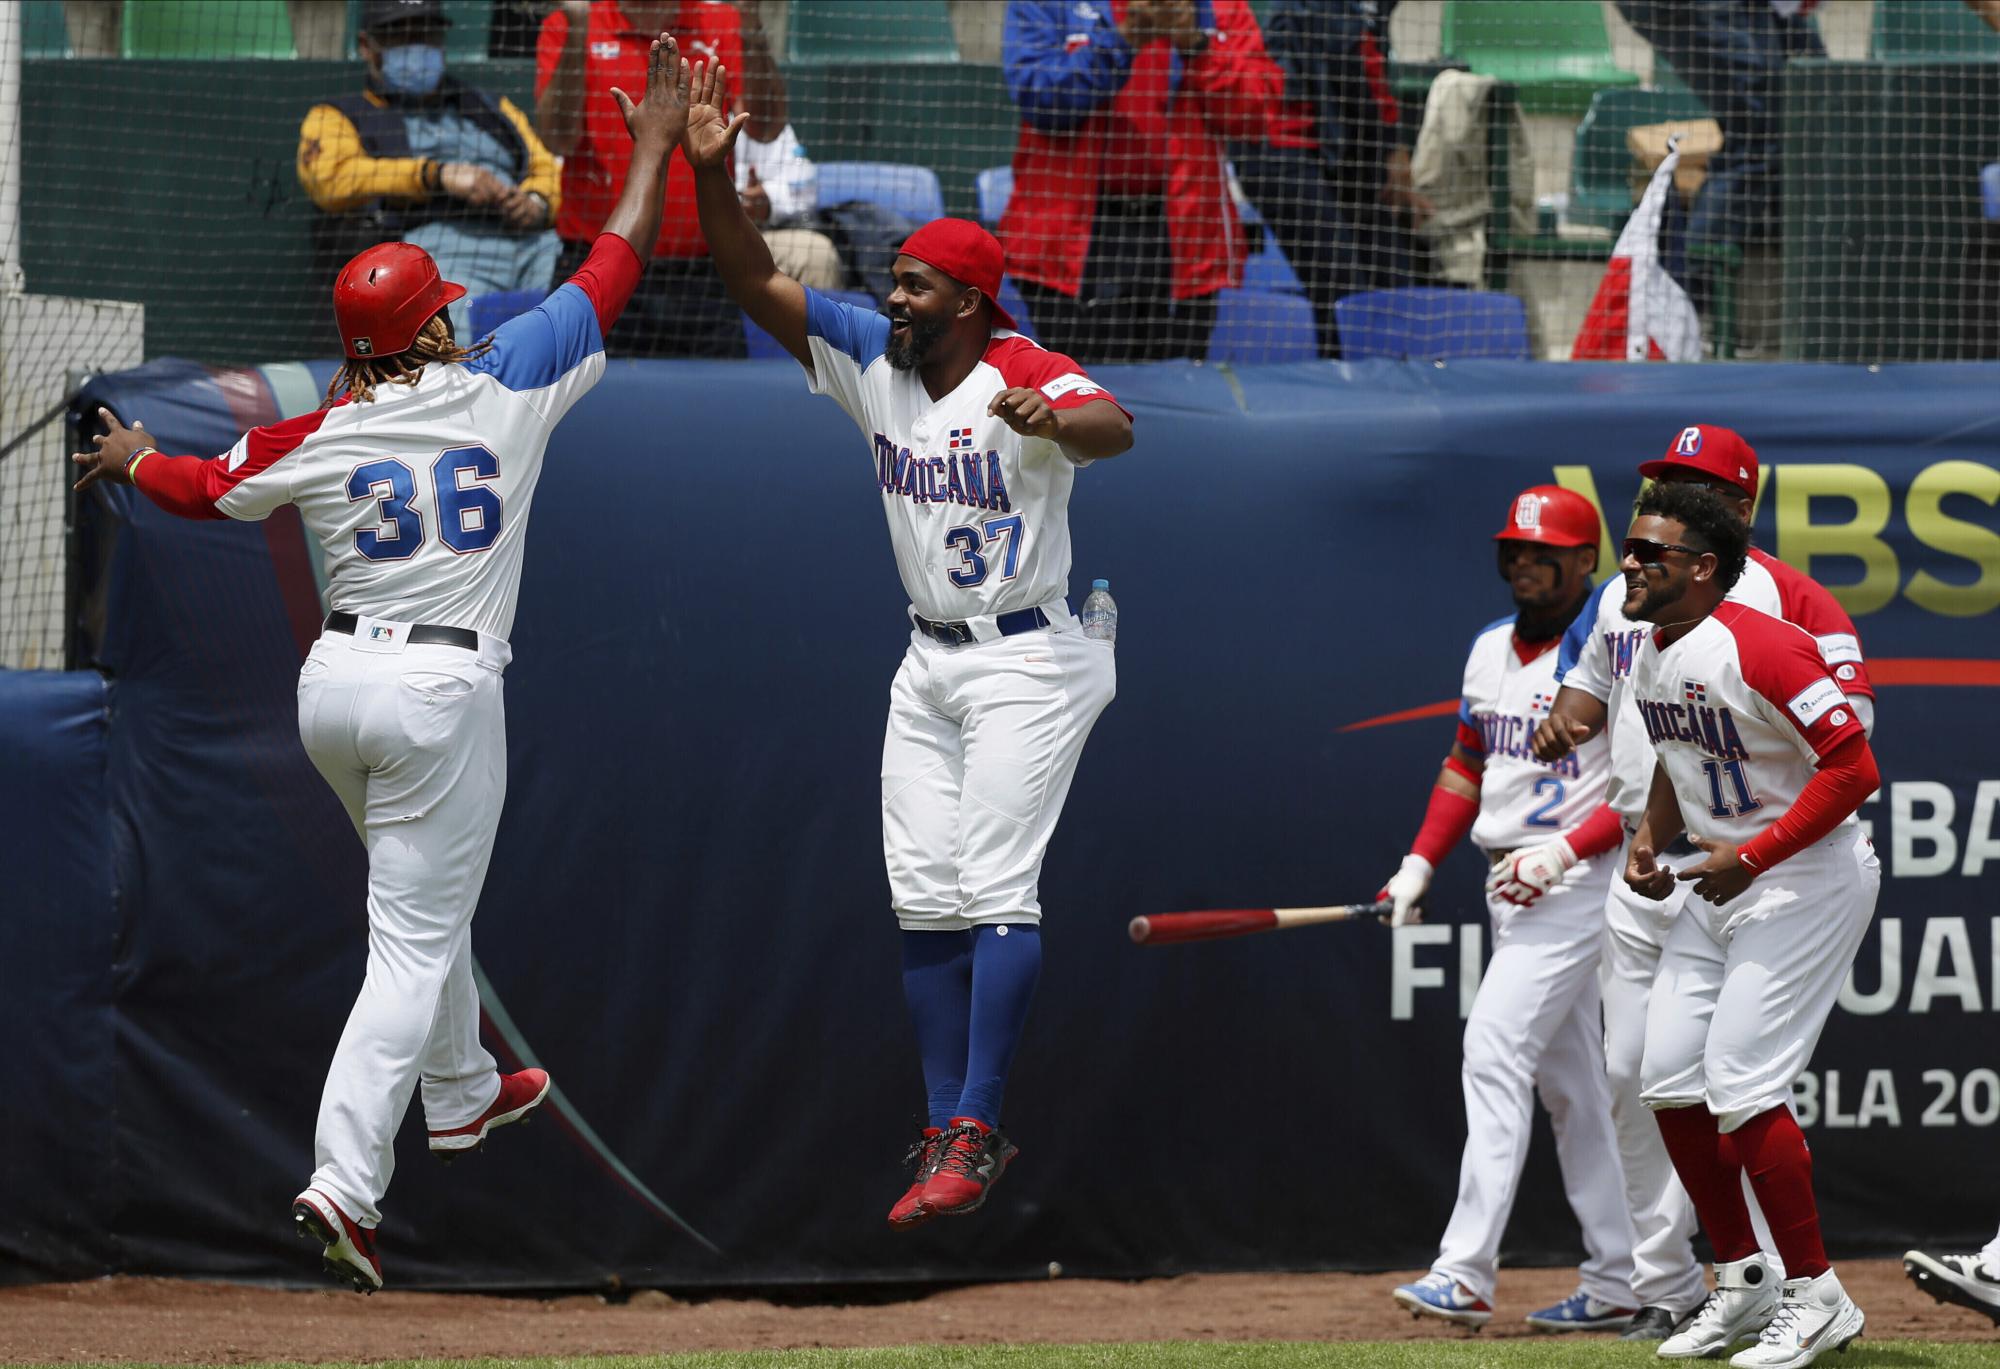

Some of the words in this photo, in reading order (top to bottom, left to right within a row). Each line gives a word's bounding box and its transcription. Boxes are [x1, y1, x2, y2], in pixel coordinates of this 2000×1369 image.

[345, 443, 504, 562] 36
[944, 512, 1026, 588] 37
[1522, 777, 1567, 828] 2
[1701, 759, 1763, 819] 11
